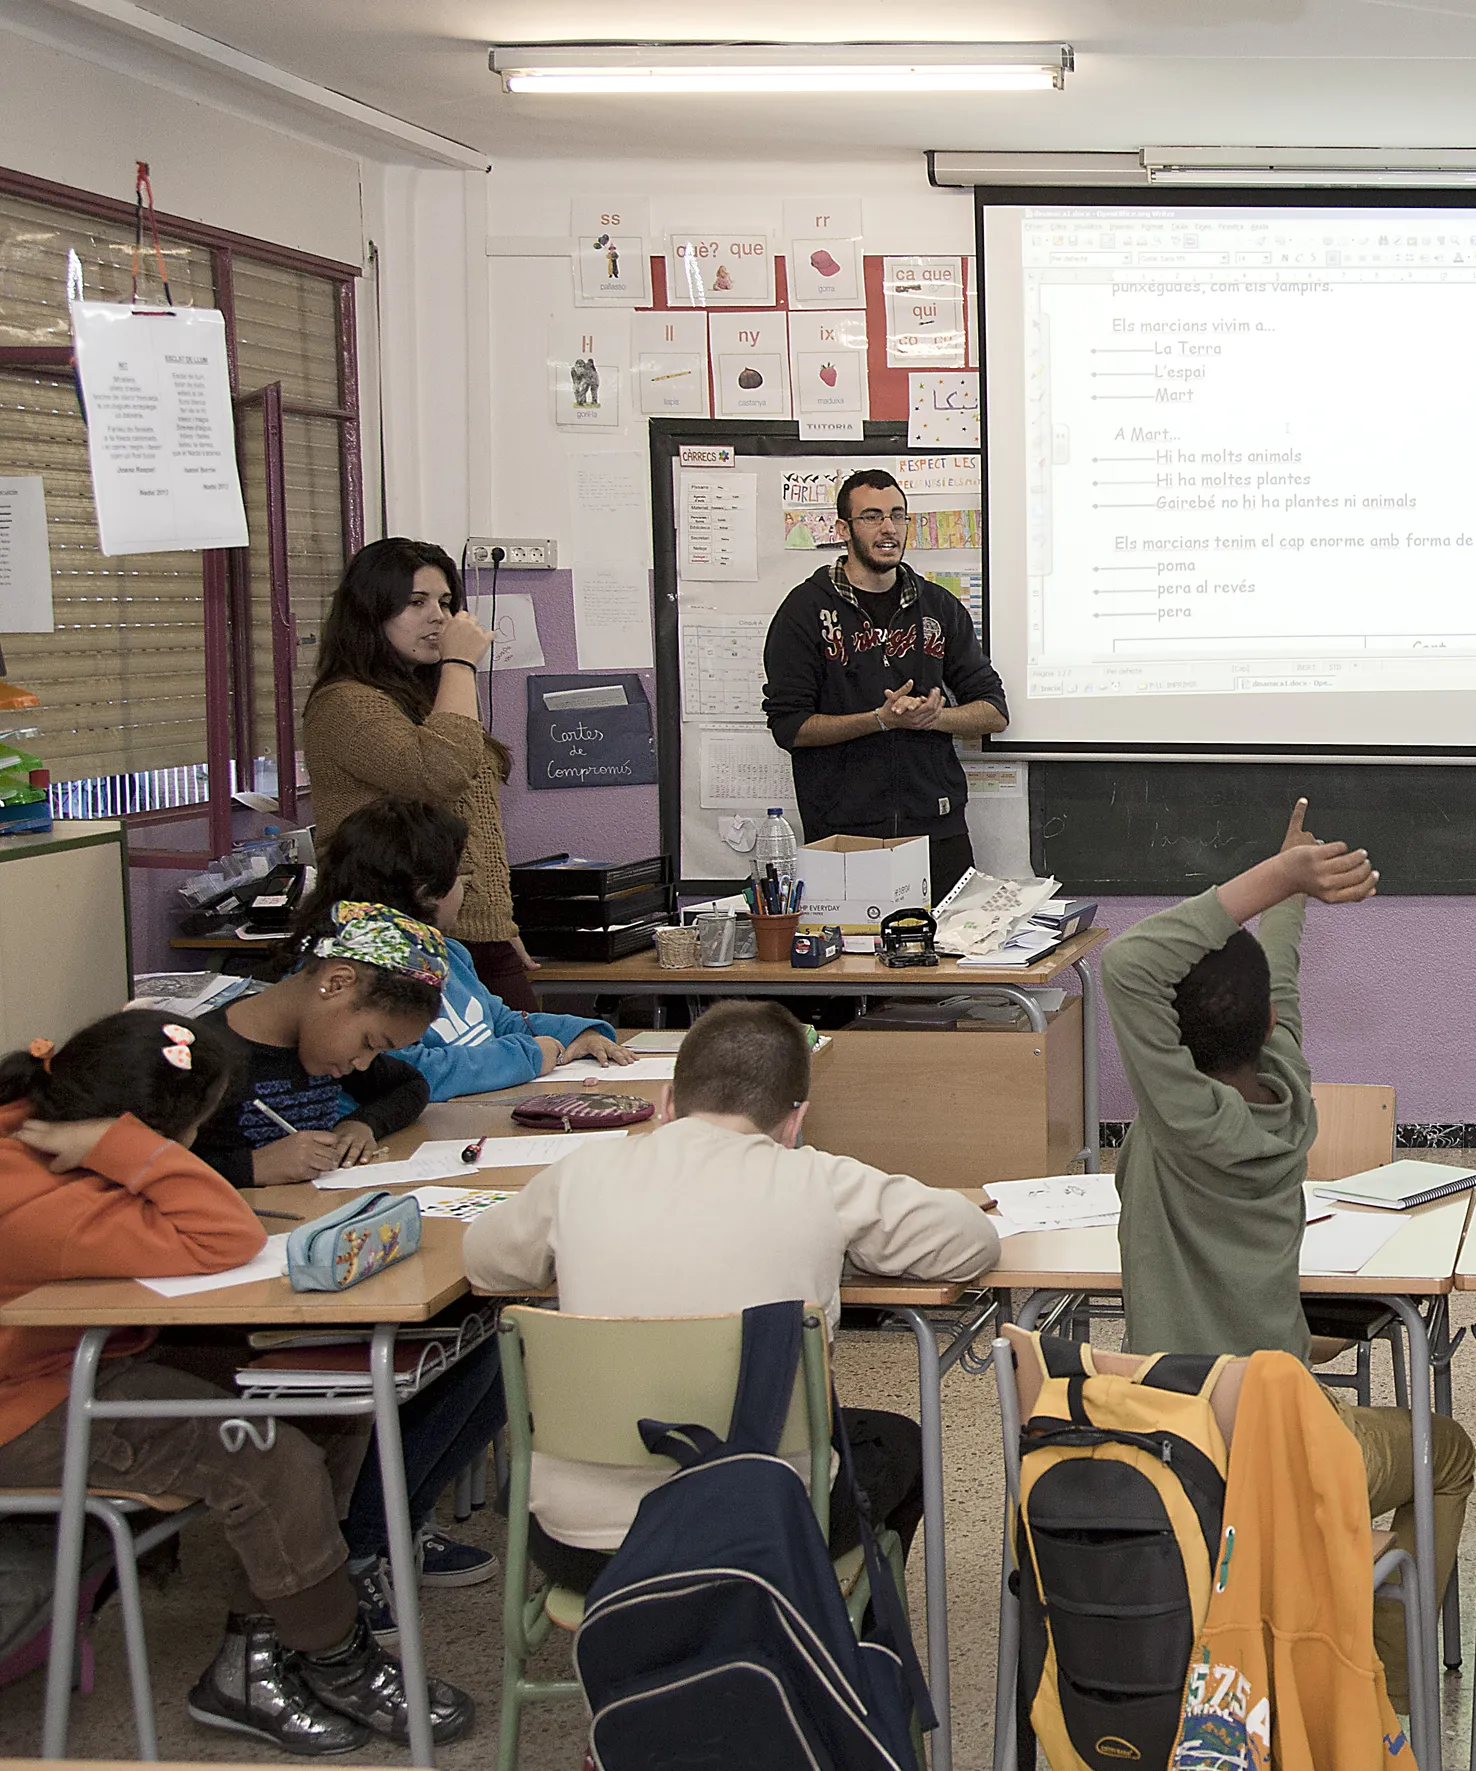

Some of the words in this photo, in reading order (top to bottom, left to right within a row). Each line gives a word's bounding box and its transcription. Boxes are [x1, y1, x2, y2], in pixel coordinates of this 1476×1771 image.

[600, 213, 621, 226] ss
[815, 214, 830, 227] rr
[1096, 210, 1151, 218] OpenOffice.org
[729, 243, 764, 259] que
[895, 269, 916, 281] ca
[922, 269, 952, 285] que
[912, 303, 937, 319] qui
[1113, 318, 1134, 331] Els
[1141, 319, 1207, 331] marcians
[1212, 319, 1249, 331] vivim
[1256, 323, 1274, 331] a...
[738, 330, 760, 348] ny
[820, 325, 835, 341] ix
[1153, 342, 1172, 355] La
[1178, 341, 1221, 354] Terra
[1155, 365, 1206, 382] L'espai
[1155, 388, 1193, 401] Mart
[737, 399, 767, 407] castanya
[1115, 428, 1127, 441] A
[1131, 428, 1180, 441] Mart...
[682, 448, 717, 462] CÀRRECS
[1156, 450, 1174, 463] Hi
[1178, 450, 1195, 462] ha
[1202, 451, 1242, 462] molts
[1248, 449, 1301, 461] animals
[899, 457, 947, 473] RESPECT
[954, 457, 976, 469] LES
[1156, 473, 1174, 486] Hi
[1178, 473, 1197, 486] ha
[1202, 472, 1251, 485] moltes
[1258, 472, 1310, 489] plantes
[1156, 495, 1216, 509] Gairebé
[1222, 498, 1239, 509] no
[1243, 494, 1257, 508] hi
[1262, 495, 1279, 507] ha
[1286, 494, 1338, 511] plantes
[1345, 495, 1357, 508] ni
[1362, 493, 1416, 507] animals
[1116, 536, 1137, 549] Els
[1143, 536, 1210, 549] marcians
[1215, 535, 1256, 548] tenim
[1262, 534, 1273, 547] el
[1280, 538, 1305, 552] cap
[1310, 538, 1364, 546] enorme
[1371, 533, 1399, 546] amb
[1406, 533, 1450, 546] forma
[1456, 533, 1473, 546] de
[1157, 562, 1196, 577] poma
[1157, 585, 1192, 599] pera
[1196, 580, 1207, 593] al
[1215, 580, 1255, 593] revés
[1157, 606, 1192, 621] pera
[1252, 680, 1308, 688] dinamica1.docx
[550, 721, 604, 743] Cartes
[569, 745, 587, 756] de
[547, 759, 632, 782] Compromís
